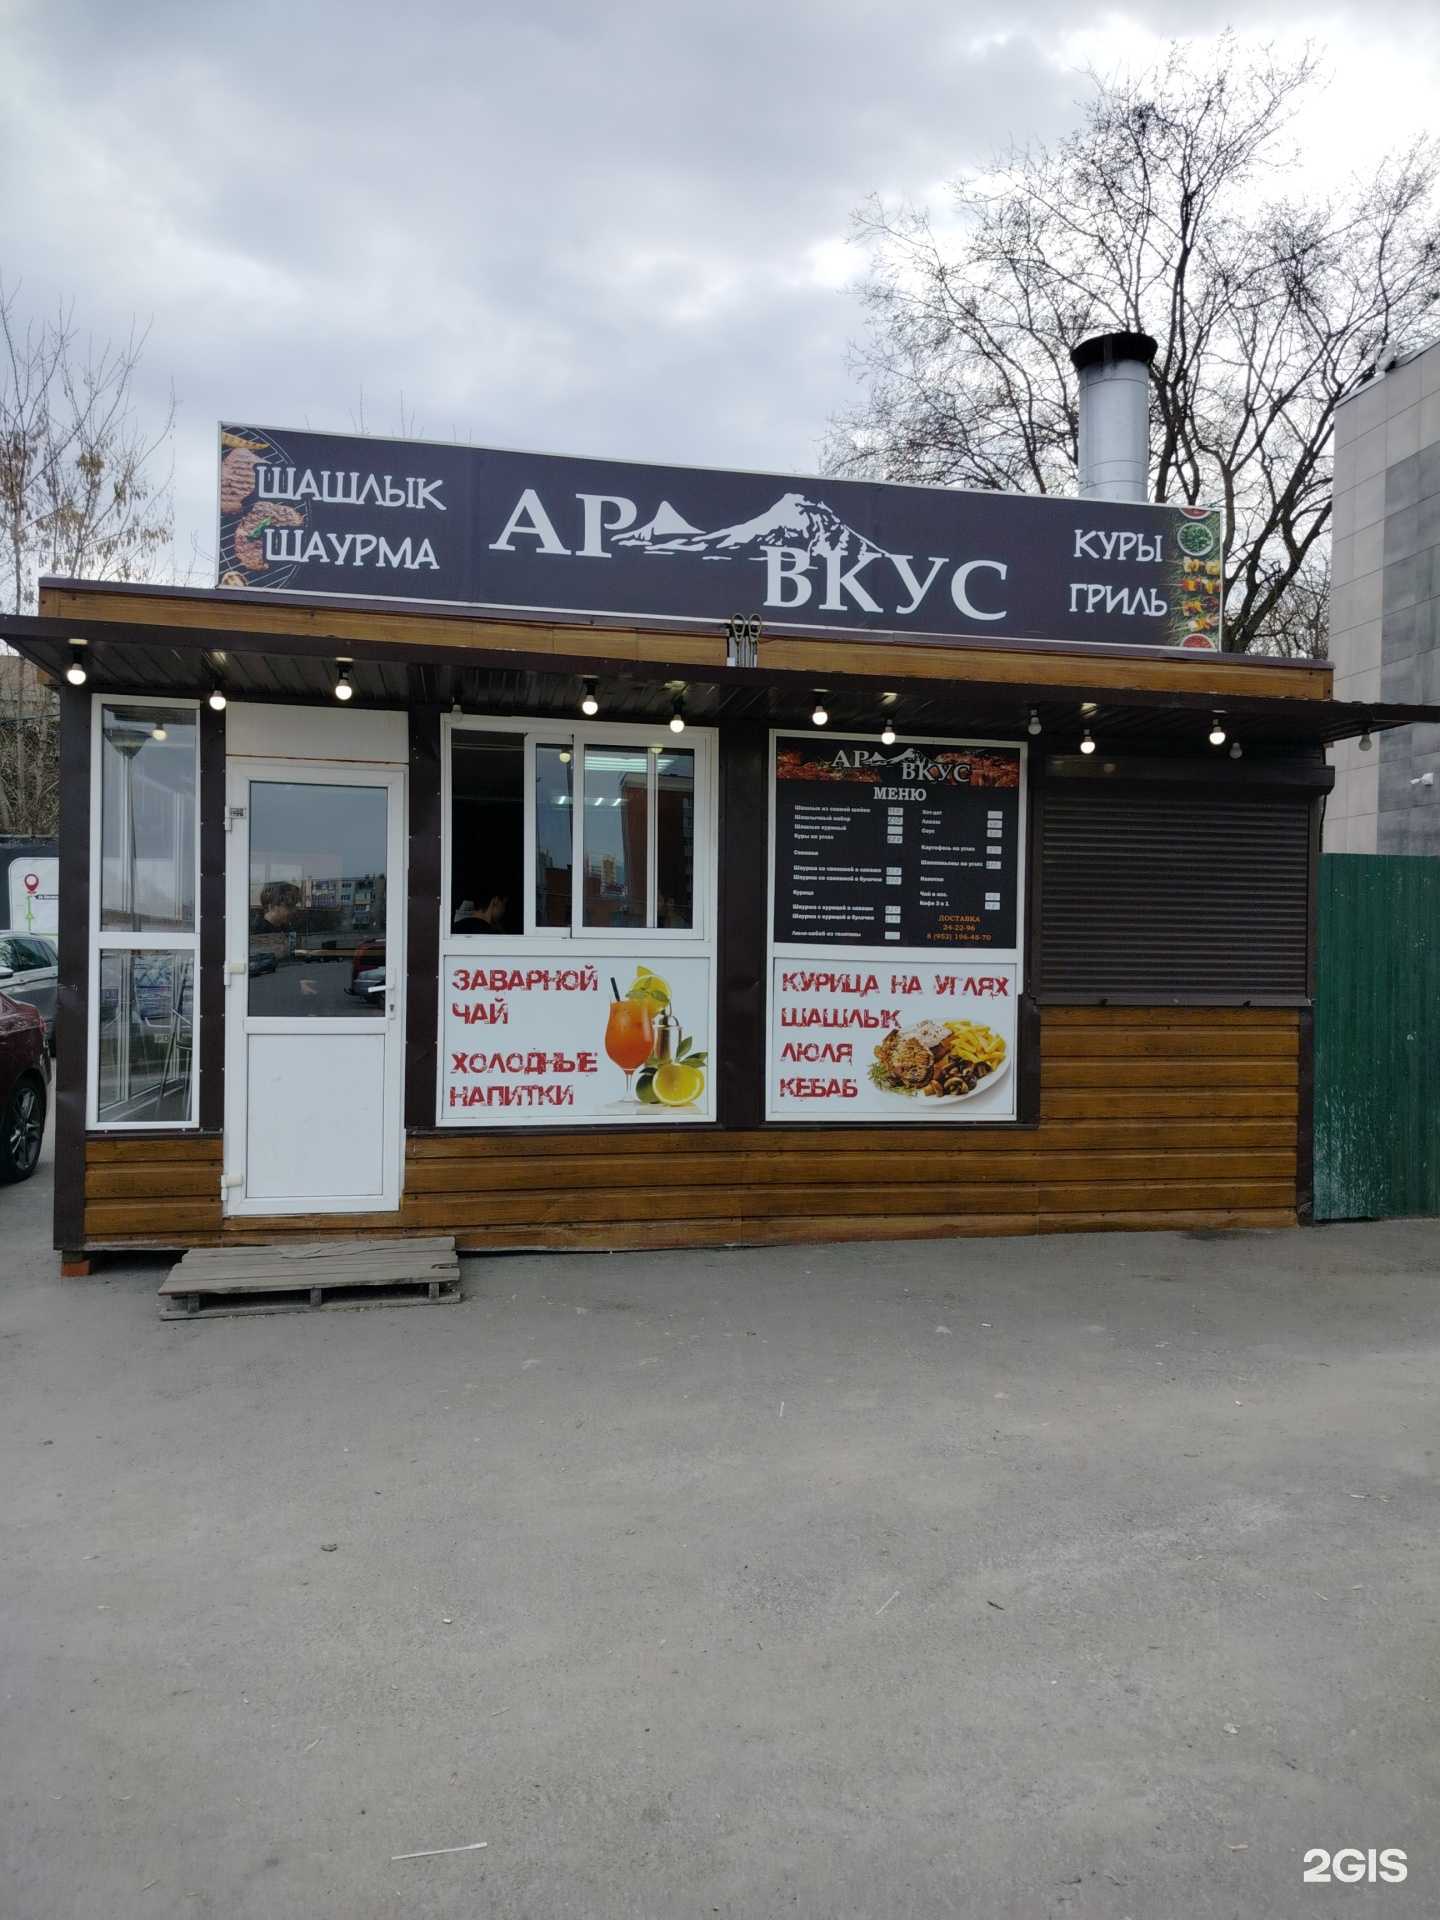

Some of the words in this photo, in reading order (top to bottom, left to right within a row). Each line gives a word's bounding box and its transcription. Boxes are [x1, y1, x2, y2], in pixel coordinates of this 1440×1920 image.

[256, 466, 447, 511] ШАШЛЫК
[264, 529, 440, 570] ШАУРМА
[1073, 529, 1162, 562] КУРЫ
[760, 545, 1008, 621] ВКУС
[1069, 583, 1168, 616] ГРИЛЬ
[902, 762, 970, 782] ВКУС
[873, 787, 927, 801] МЕНЮ
[451, 965, 598, 992] ЗАВАРНОЙ
[782, 971, 880, 997] КУРИЦА
[891, 975, 922, 994] НА
[935, 975, 1010, 998] УГЛЯХ
[451, 997, 509, 1025] ЧАЙ
[781, 1007, 901, 1028] ШАШЛЫК
[781, 1043, 854, 1063] ЛЮЛЯ
[450, 1085, 575, 1107] НАПИТКИ
[779, 1078, 859, 1098] КЕБАБ
